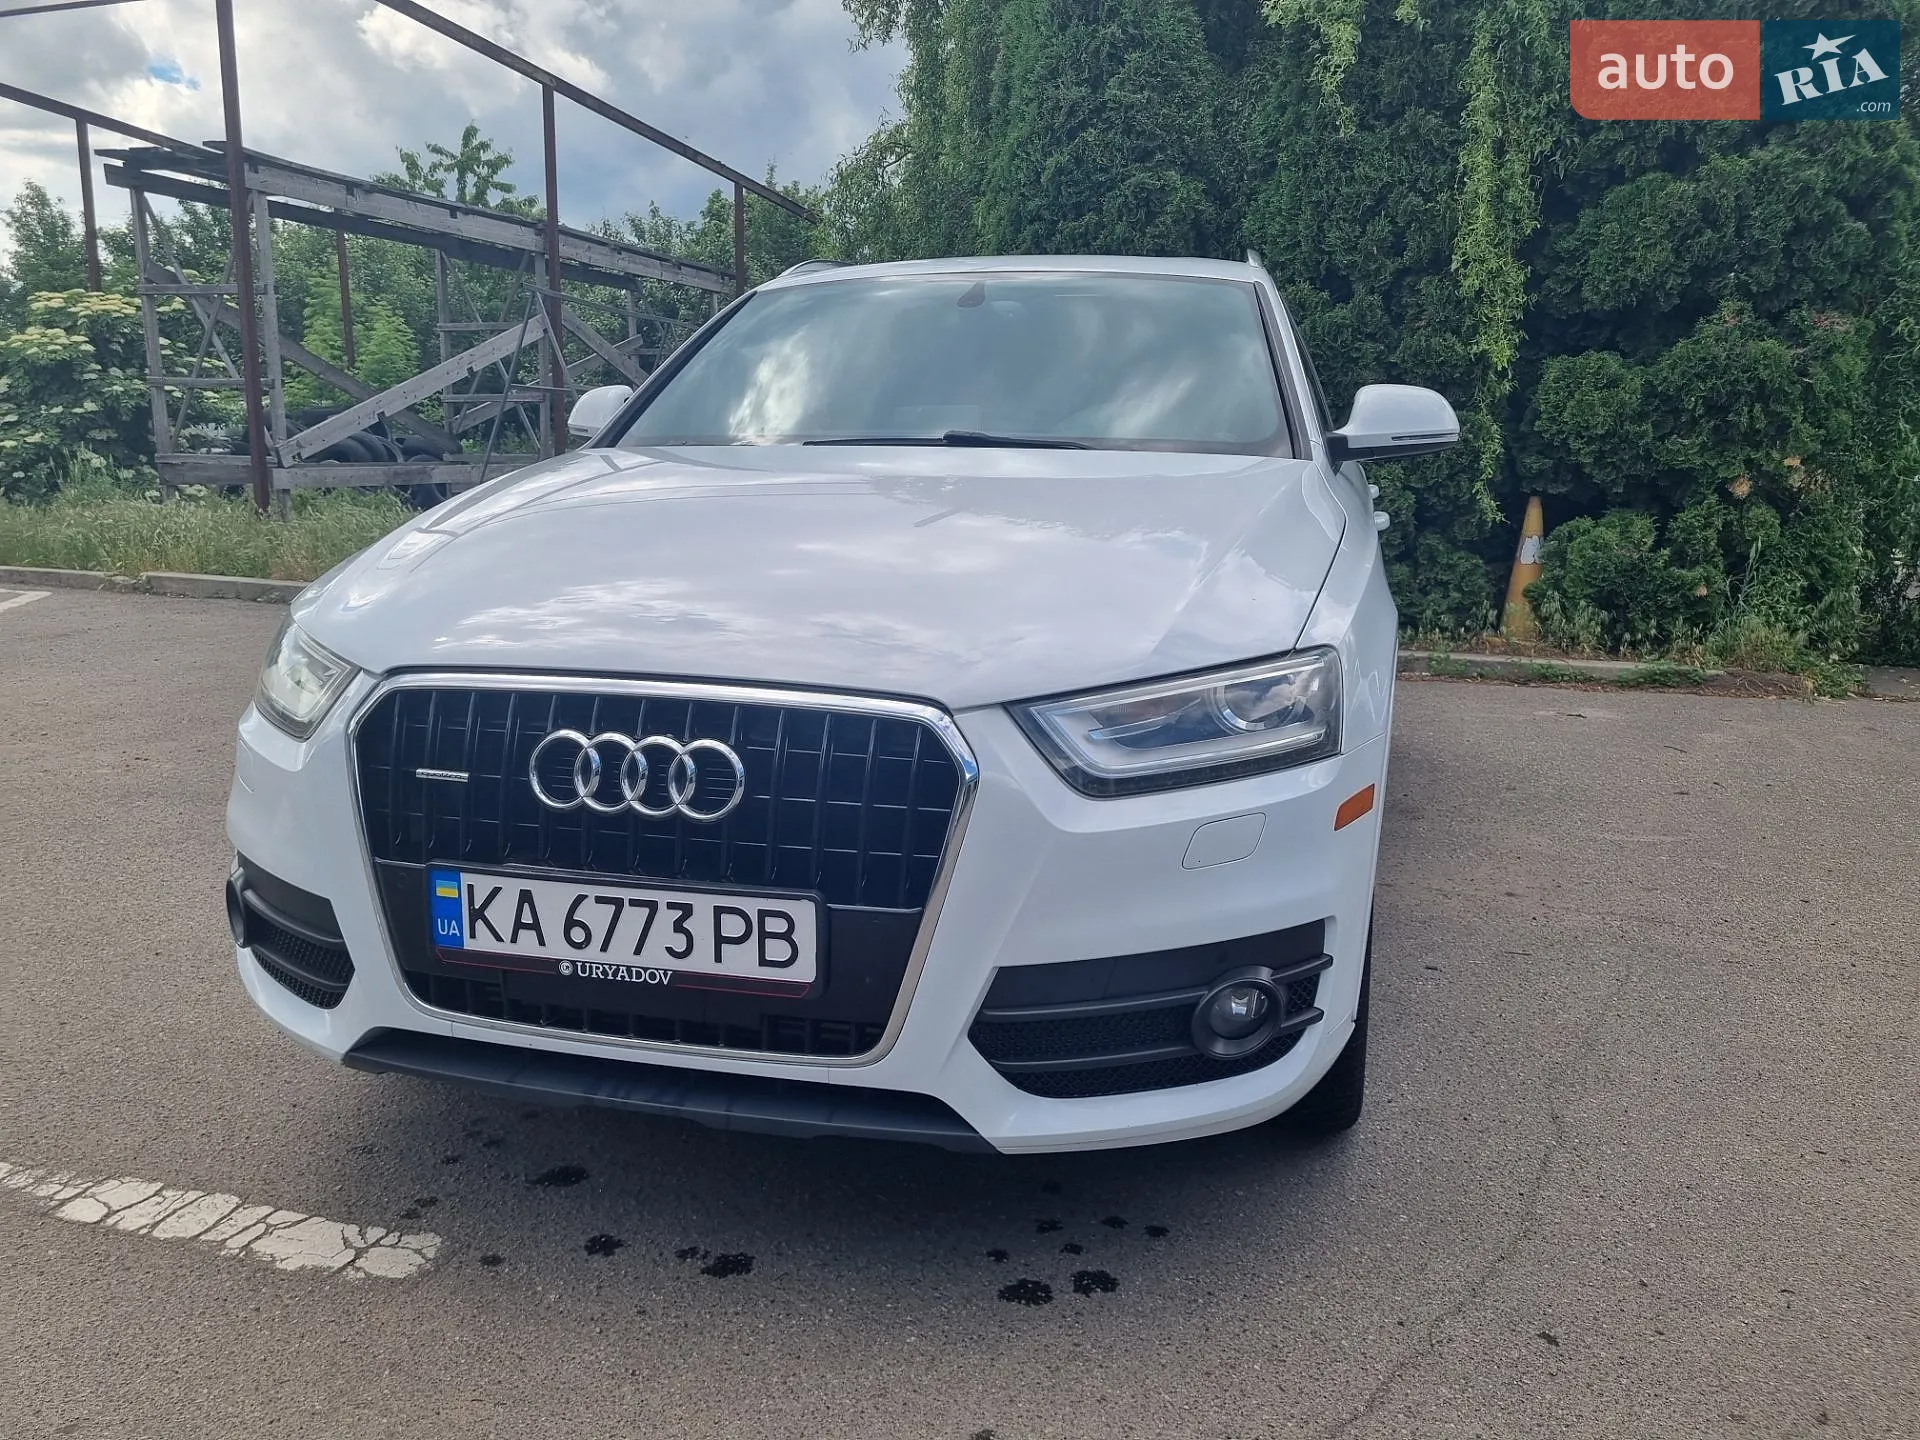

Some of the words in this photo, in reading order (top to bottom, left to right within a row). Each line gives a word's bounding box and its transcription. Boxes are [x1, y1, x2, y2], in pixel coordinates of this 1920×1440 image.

[437, 918, 460, 937] UA
[467, 883, 546, 947] KA
[563, 894, 694, 959] 6773
[713, 904, 800, 969] PB
[576, 961, 673, 985] URYADOV
